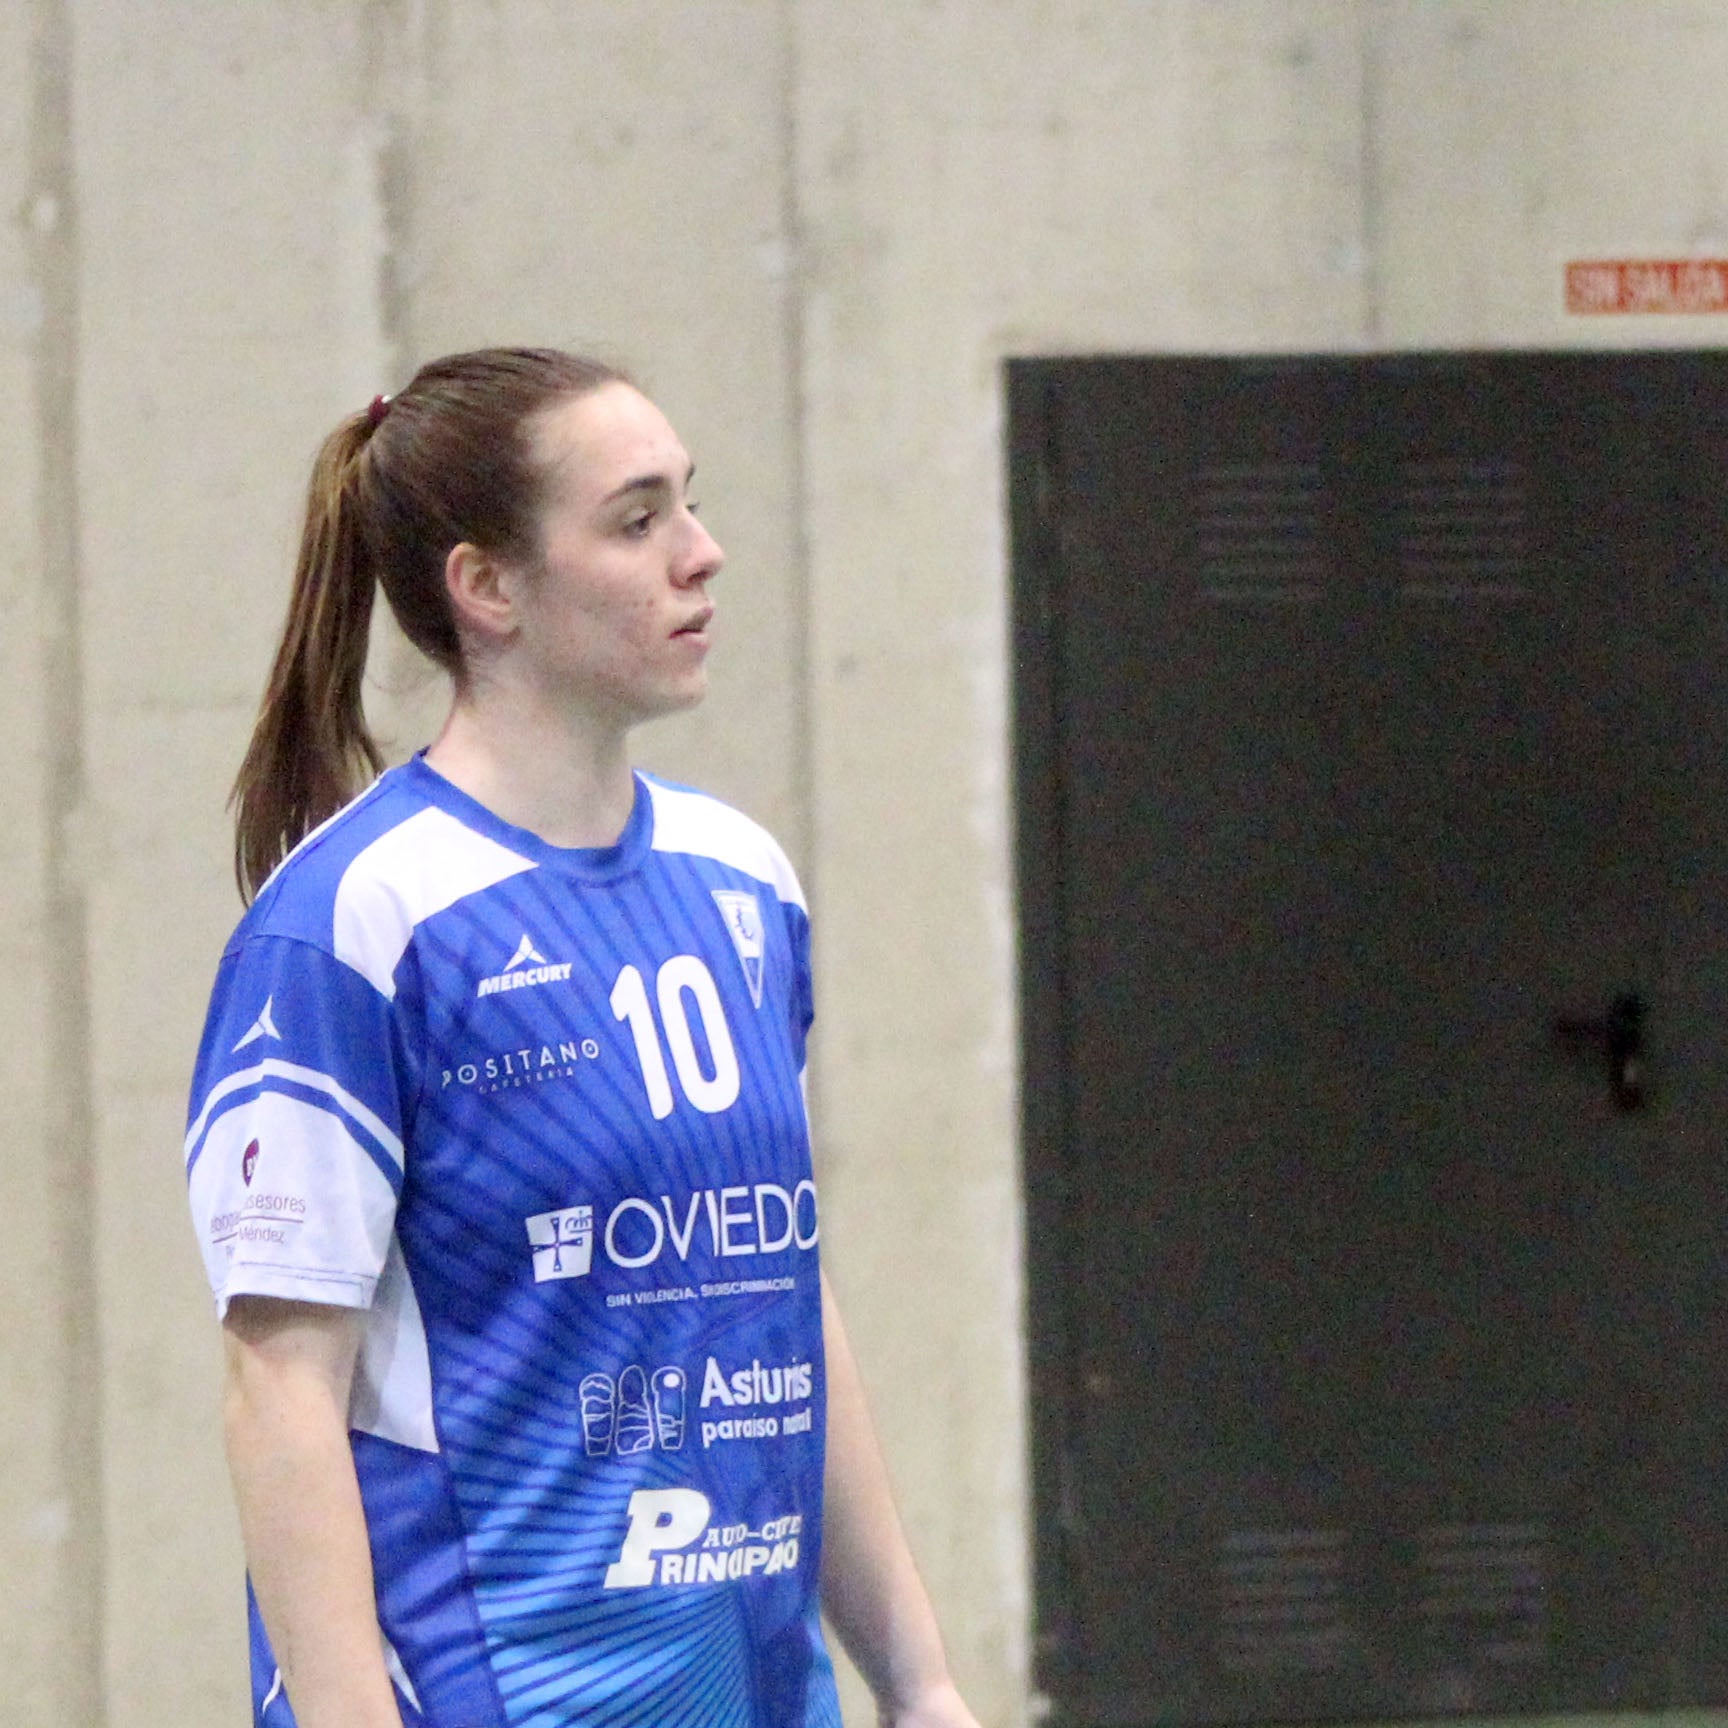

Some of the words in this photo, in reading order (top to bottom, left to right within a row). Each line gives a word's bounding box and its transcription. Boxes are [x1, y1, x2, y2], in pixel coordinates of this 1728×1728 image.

[477, 963, 572, 998] MERCURY
[441, 1038, 600, 1089] POSITANO
[609, 954, 741, 1121] 10
[604, 1179, 819, 1268] OVIEDO
